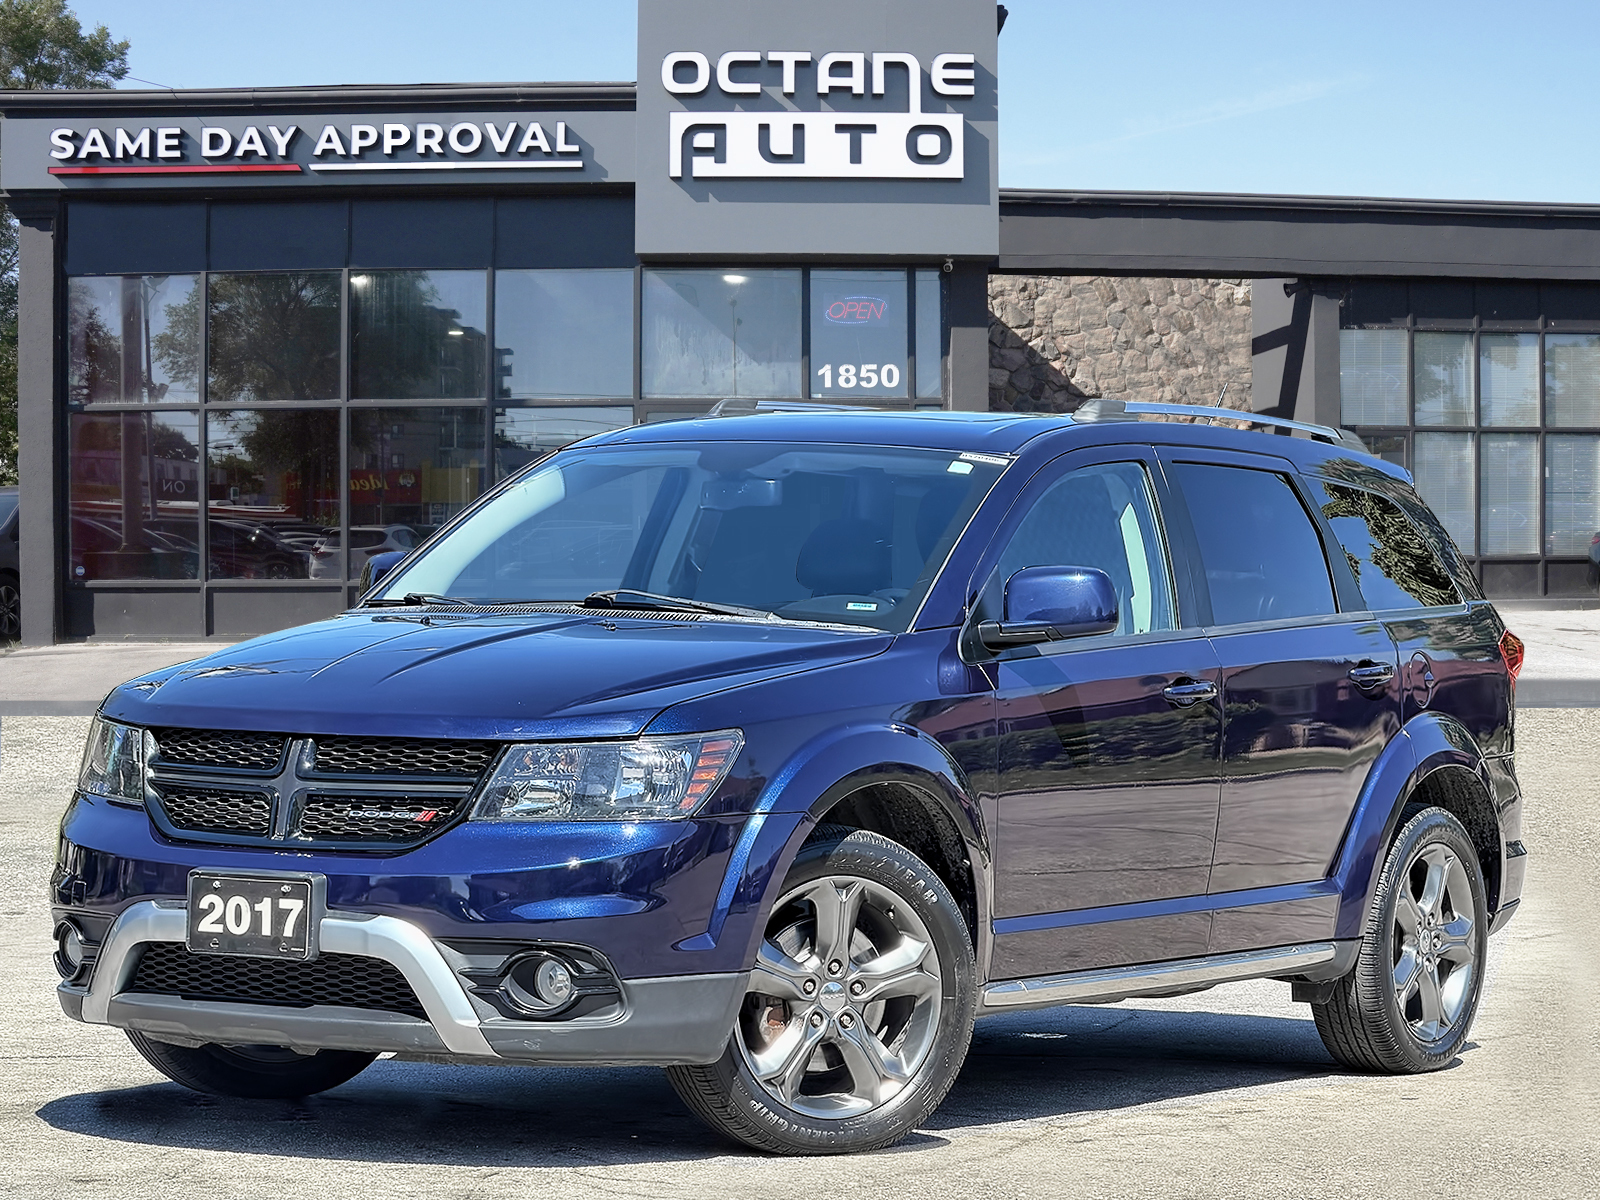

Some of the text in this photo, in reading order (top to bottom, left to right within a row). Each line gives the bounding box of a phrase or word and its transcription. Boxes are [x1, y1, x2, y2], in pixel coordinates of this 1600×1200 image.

[661, 51, 976, 96] OCTANE
[49, 121, 581, 160] SAME DAY APPROVAL
[681, 124, 953, 177] AUTO
[829, 301, 885, 319] OPEN
[817, 363, 900, 388] 1850
[198, 894, 304, 938] 2017
